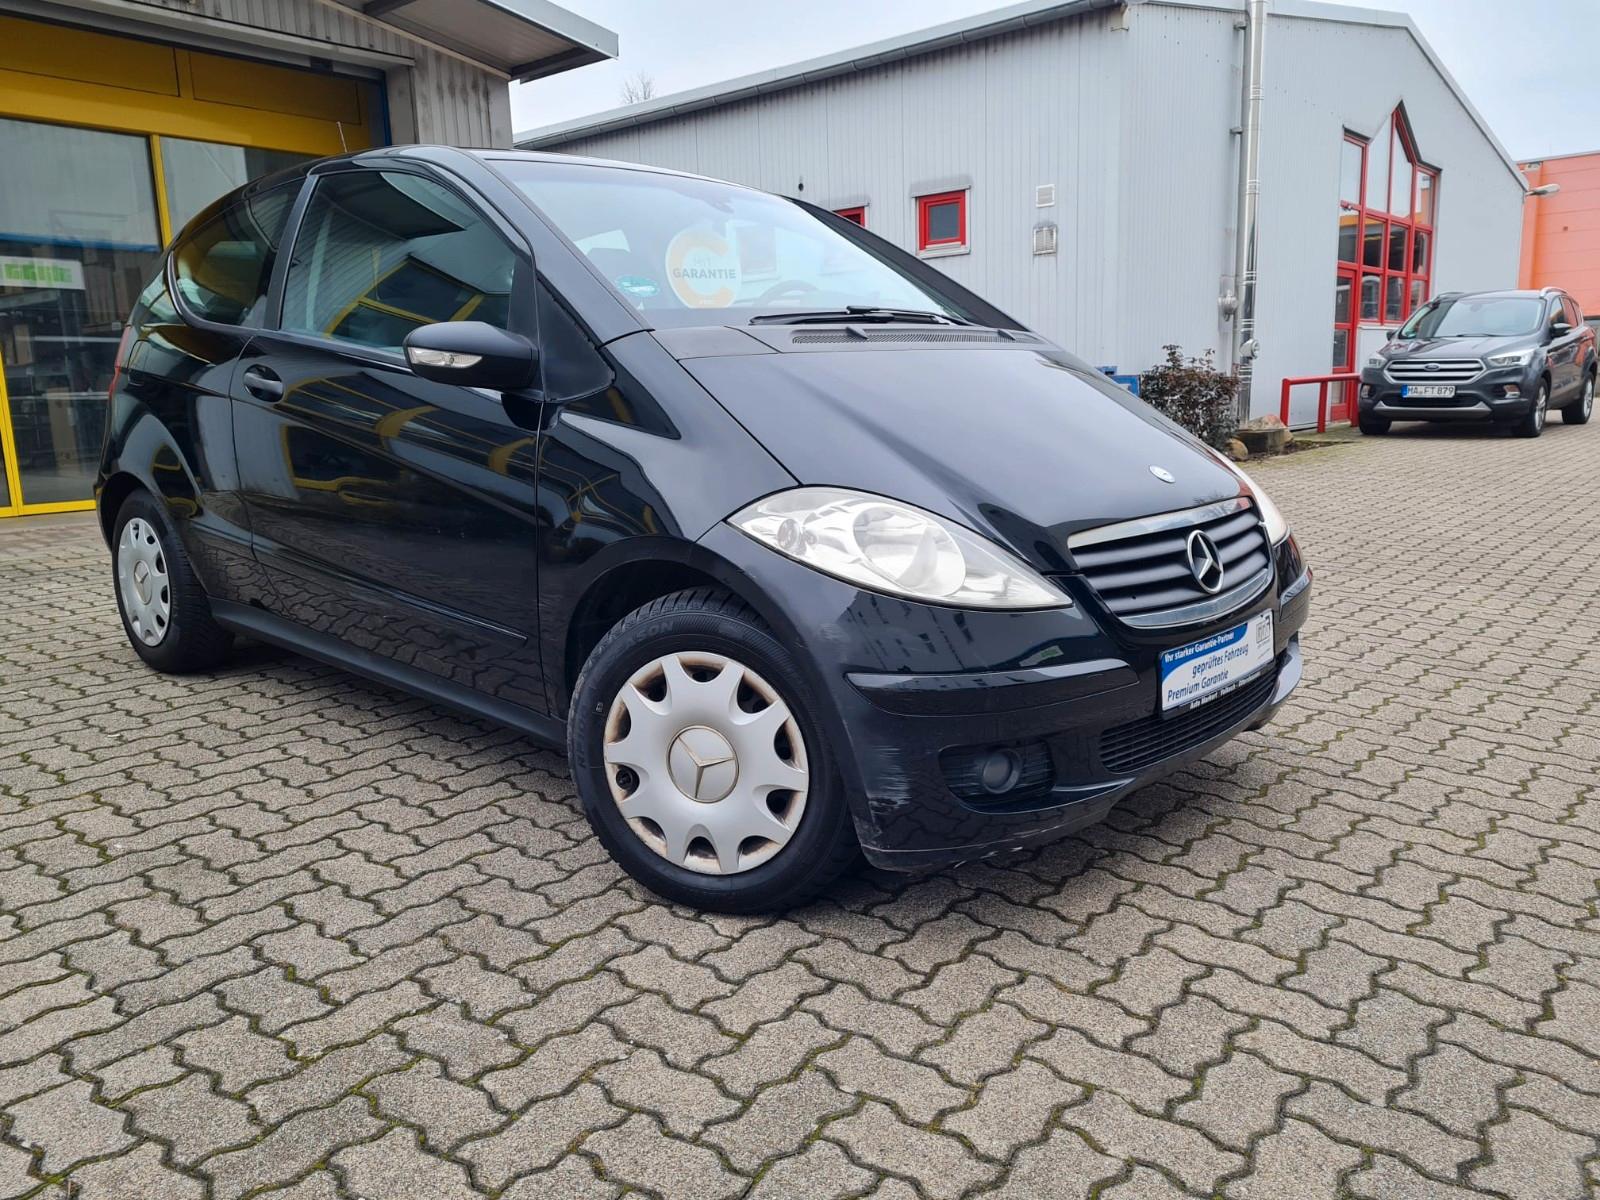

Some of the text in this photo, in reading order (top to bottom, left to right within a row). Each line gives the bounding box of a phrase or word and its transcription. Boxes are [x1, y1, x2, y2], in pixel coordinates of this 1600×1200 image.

[672, 267, 737, 280] GARANTIE
[1174, 646, 1194, 660] starker
[1192, 654, 1224, 678] geprüftes
[1224, 643, 1249, 663] Fahrzeug
[1167, 681, 1200, 702] Premium
[1201, 668, 1229, 689] Garantie
